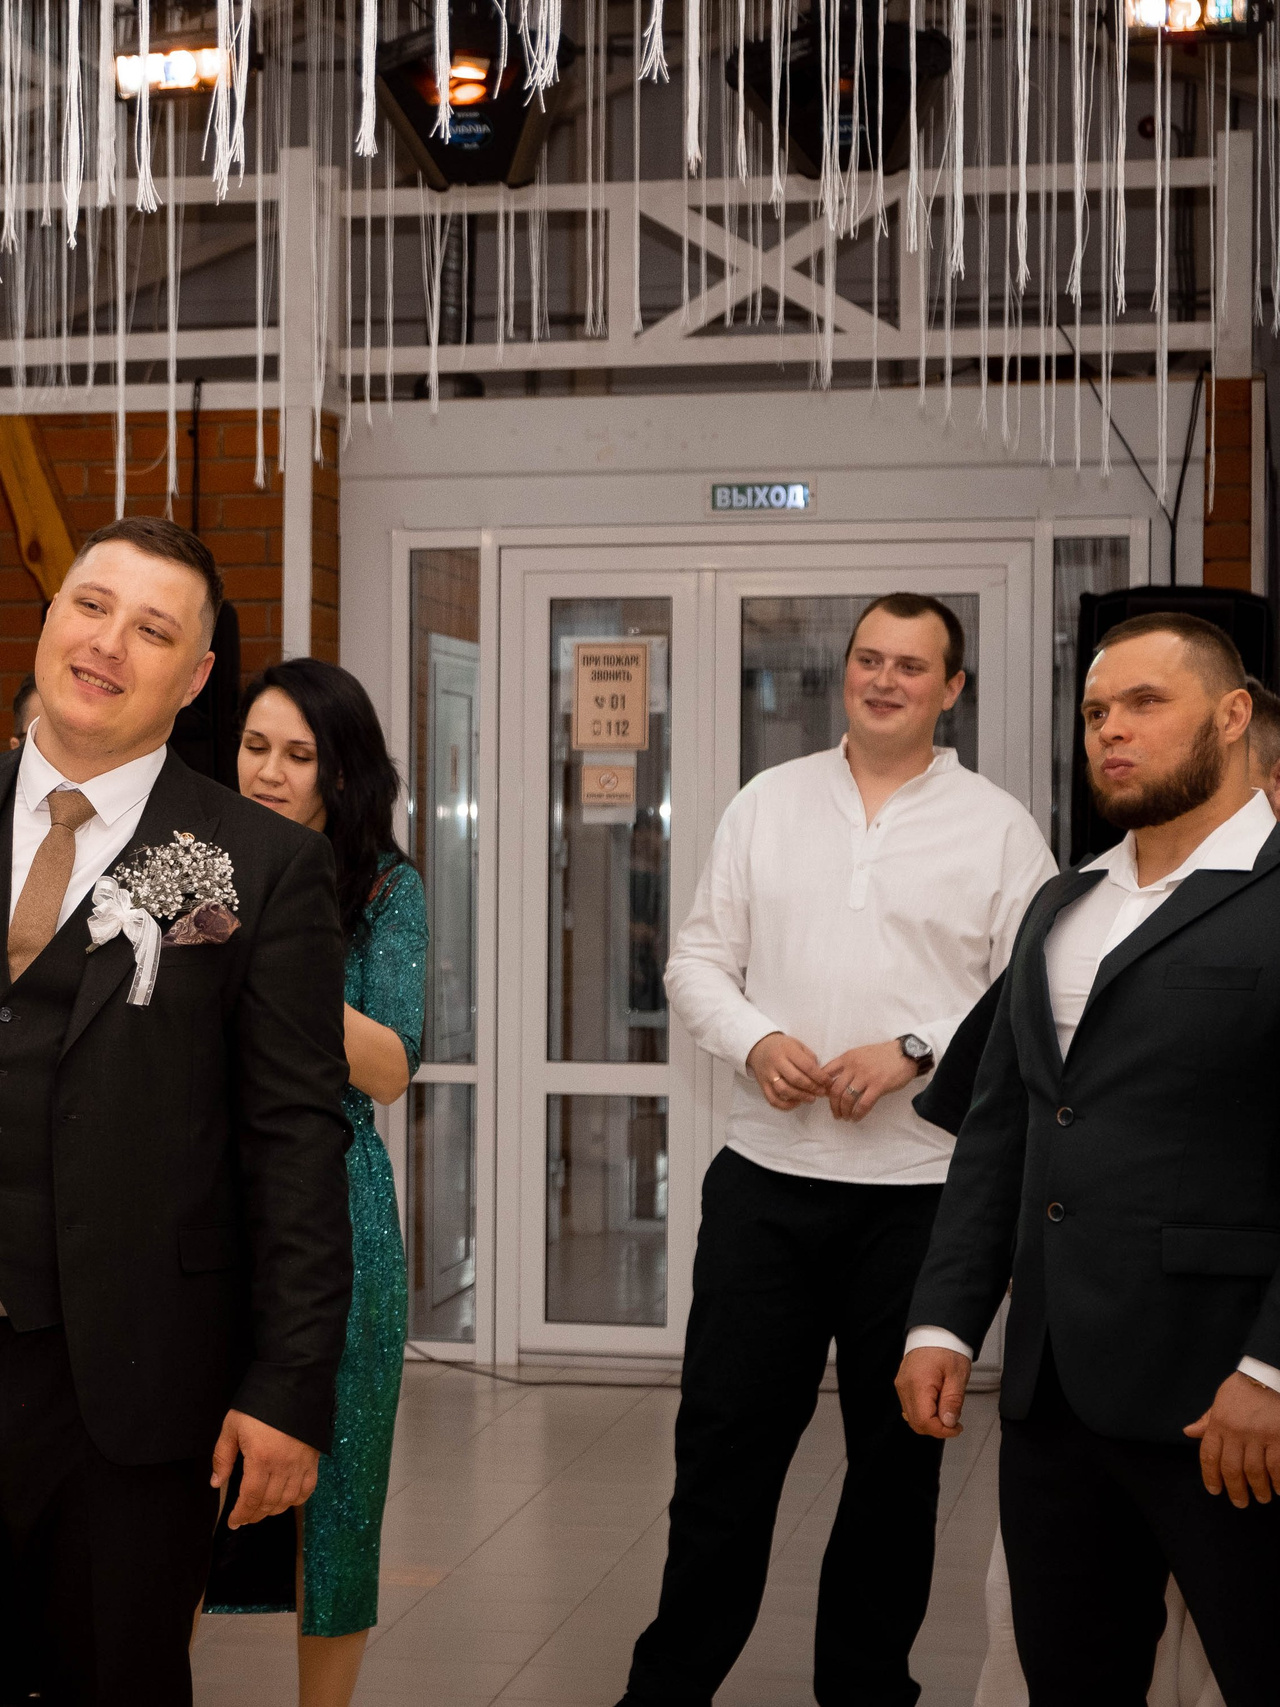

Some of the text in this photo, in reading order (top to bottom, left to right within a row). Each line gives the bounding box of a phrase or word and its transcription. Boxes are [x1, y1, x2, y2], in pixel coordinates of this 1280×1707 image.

[716, 484, 805, 510] ВЫХОД
[582, 655, 601, 667] ПРИ
[591, 670, 632, 682] ЗВОНИТЬ
[611, 694, 626, 711] 01
[606, 720, 629, 736] 112
